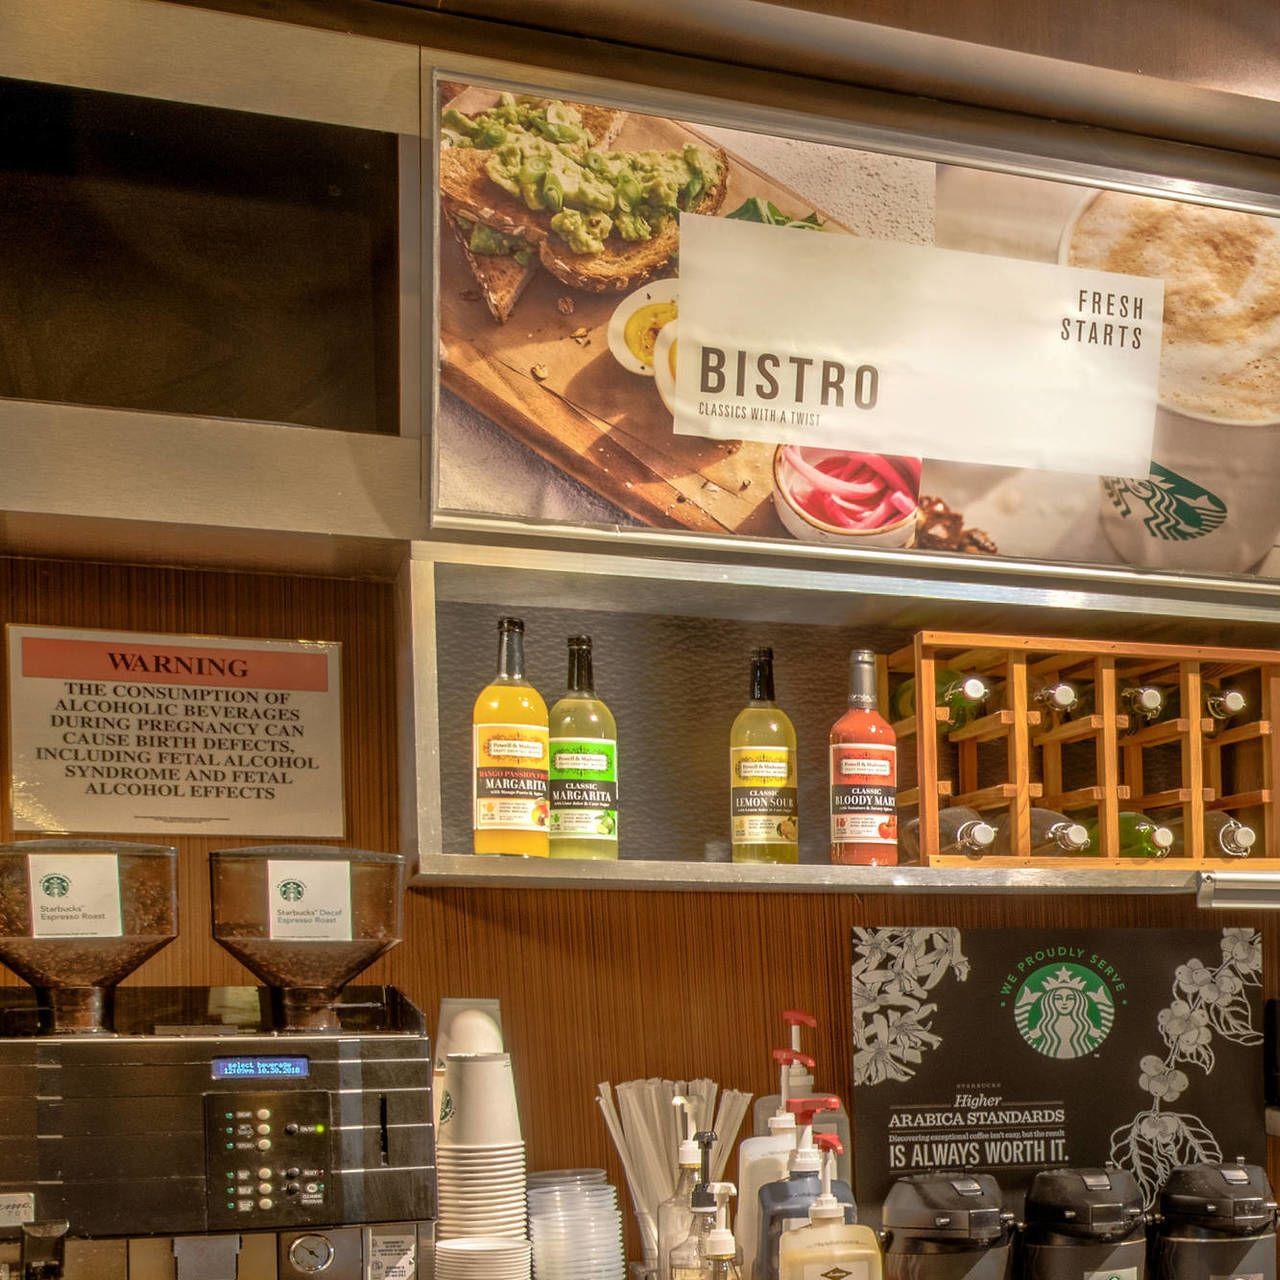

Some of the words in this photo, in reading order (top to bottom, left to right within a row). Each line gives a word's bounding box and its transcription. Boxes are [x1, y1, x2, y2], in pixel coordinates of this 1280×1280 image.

[1078, 289, 1144, 320] FRESH
[1060, 319, 1142, 350] STARTS
[700, 347, 880, 411] BISTRO
[699, 402, 746, 419] CLASSICS
[751, 408, 776, 422] WITH
[781, 411, 786, 423] A
[791, 412, 820, 426] TWIST
[108, 652, 249, 678] WARNING
[64, 682, 107, 697] THE
[113, 685, 259, 704] CONSUMPTION
[265, 691, 290, 705] OF
[55, 699, 178, 717] ALCOHOLIC
[184, 704, 300, 721] BEVERAGES
[50, 714, 131, 731] DURING
[138, 718, 260, 736] PREGNANCY
[265, 724, 304, 737] CAN
[62, 732, 130, 747] CAUSE
[136, 735, 196, 749] BIRTH
[203, 738, 295, 754] DEFECTS,
[36, 747, 151, 764] INCLUDING
[158, 752, 219, 766] FETAL
[222, 754, 319, 770] ALCOHOL
[64, 765, 180, 781] SYNDROME
[186, 769, 226, 782] AND
[232, 771, 293, 784] FETAL
[486, 779, 547, 791] MARGARITA
[85, 782, 185, 797] ALCOHOL
[191, 786, 275, 799] EFFECTS
[552, 790, 611, 802] MARGARITA
[835, 795, 871, 806] BLOODY
[736, 798, 768, 807] LEMON
[82, 912, 106, 920] Roast
[320, 908, 342, 917] Decaf
[1000, 972, 1017, 996] WE
[1018, 945, 1086, 975] PROUDLY
[1089, 951, 1127, 994] SERVE
[954, 1092, 1002, 1110] Higher
[888, 1111, 964, 1128] ARABICA
[964, 1108, 1066, 1126] STANDARDS
[888, 1132, 929, 1143] Discovering
[930, 1131, 968, 1142] exceptional
[1045, 1128, 1065, 1138] result
[889, 1146, 907, 1167] IS
[911, 1143, 981, 1166] ALWAYS
[985, 1141, 1042, 1165] WORTH
[1048, 1139, 1069, 1162] IT.
